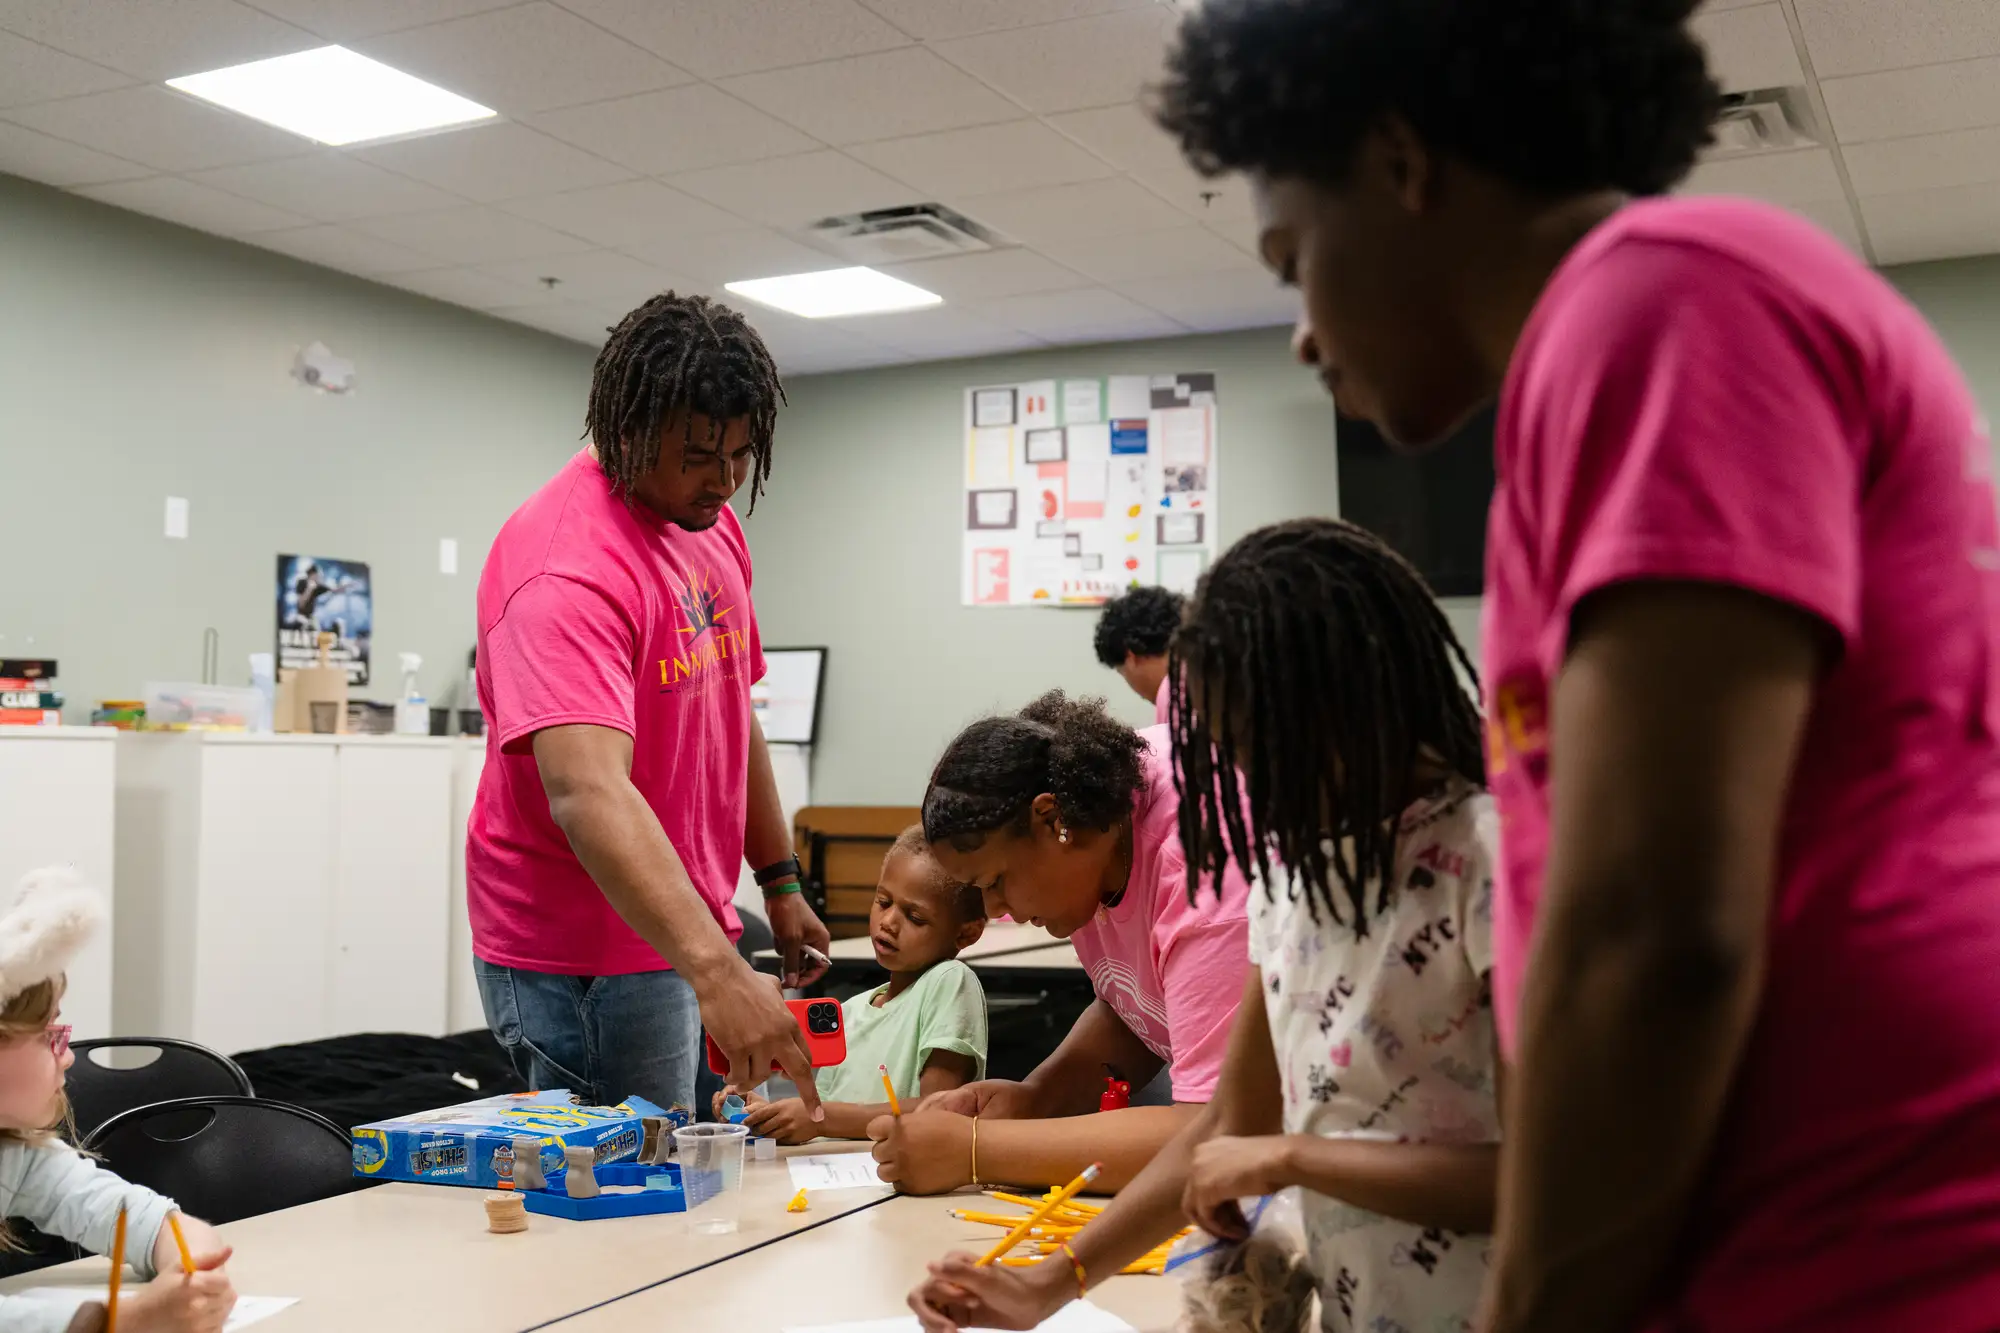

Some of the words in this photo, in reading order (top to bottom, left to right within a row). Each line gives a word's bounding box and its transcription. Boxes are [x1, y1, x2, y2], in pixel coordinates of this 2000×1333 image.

[280, 629, 338, 649] WANTD
[1, 691, 39, 708] CLUE
[1402, 917, 1454, 976] NYC
[436, 1138, 454, 1146] ACTION
[410, 1146, 469, 1171] CHASE
[431, 1169, 449, 1177] DROP
